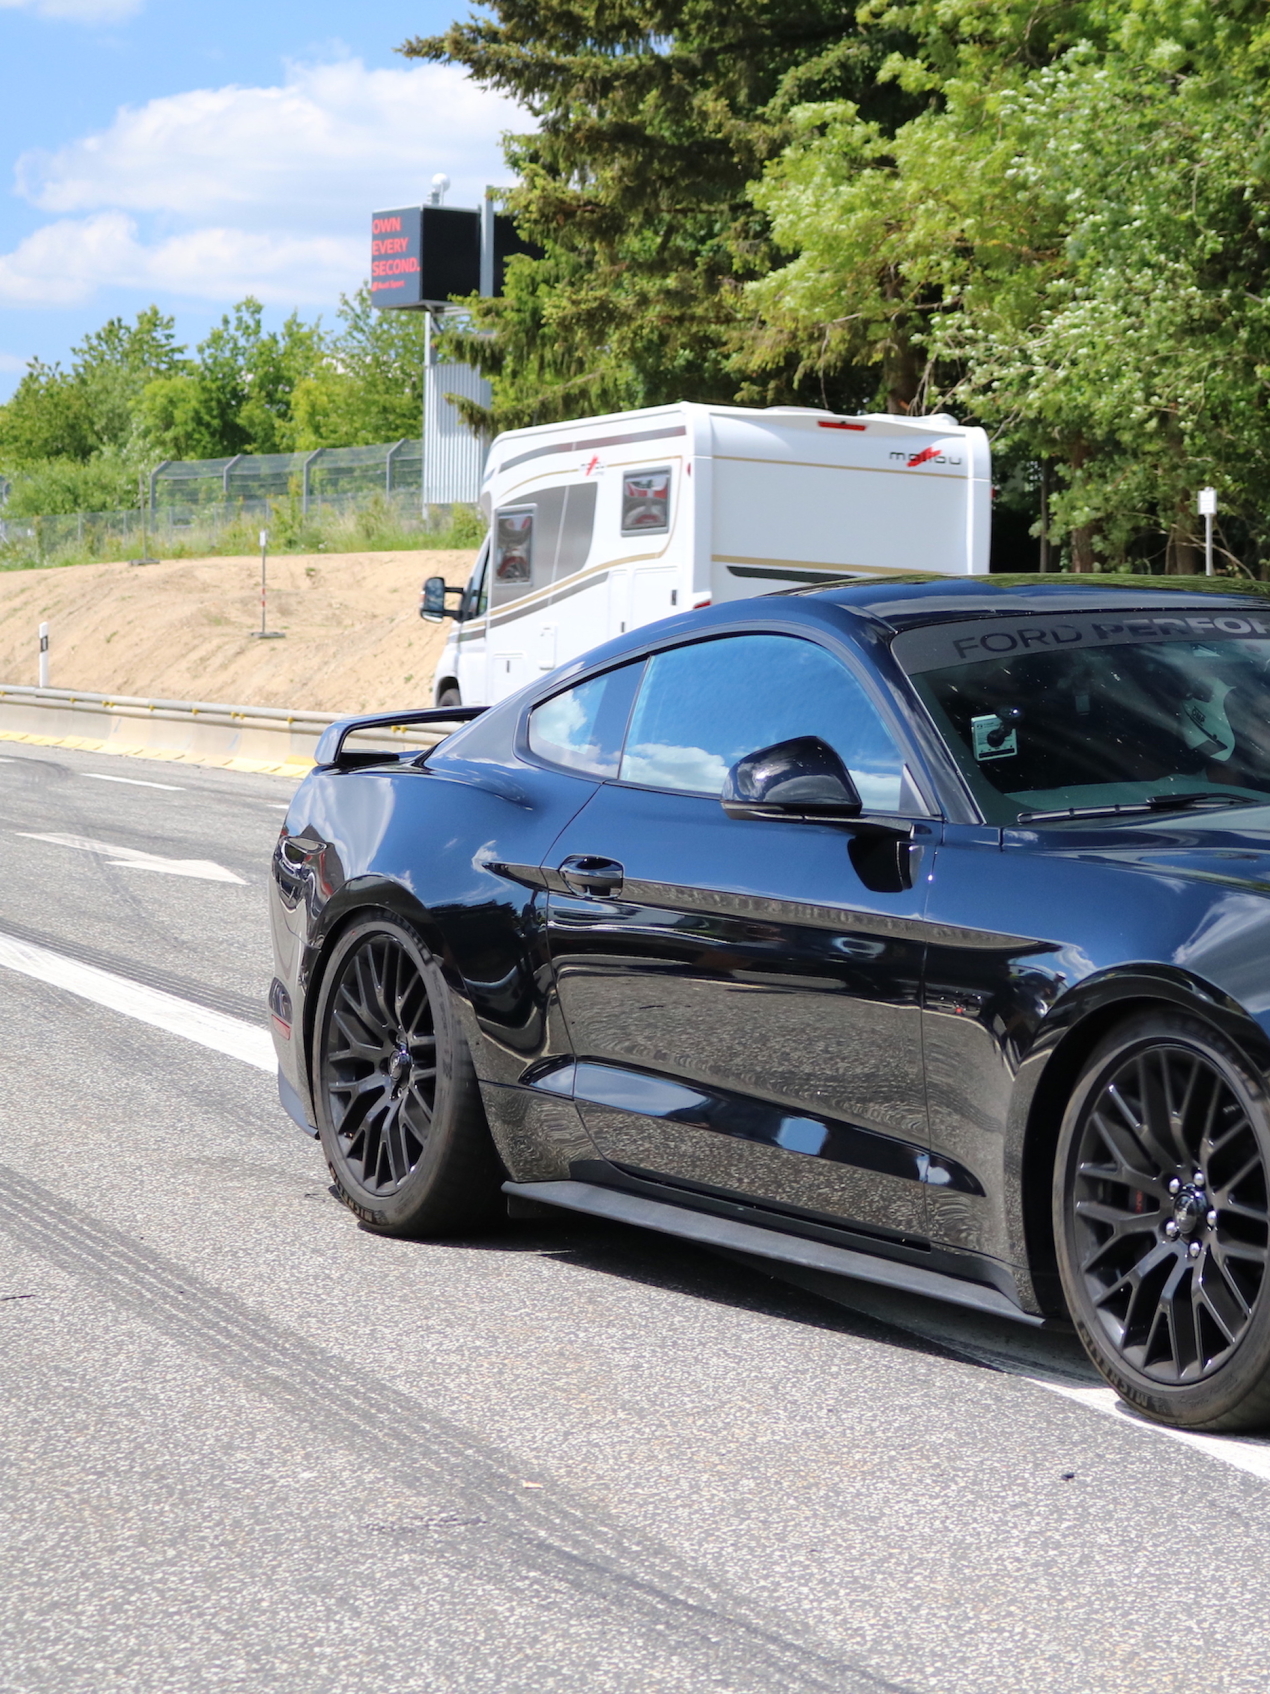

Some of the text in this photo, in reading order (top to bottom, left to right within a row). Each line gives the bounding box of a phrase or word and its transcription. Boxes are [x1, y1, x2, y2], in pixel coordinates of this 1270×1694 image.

[372, 216, 402, 234] OWN
[372, 237, 410, 255] EVERY
[372, 257, 422, 276] SECOND.
[952, 624, 1083, 659] FORD
